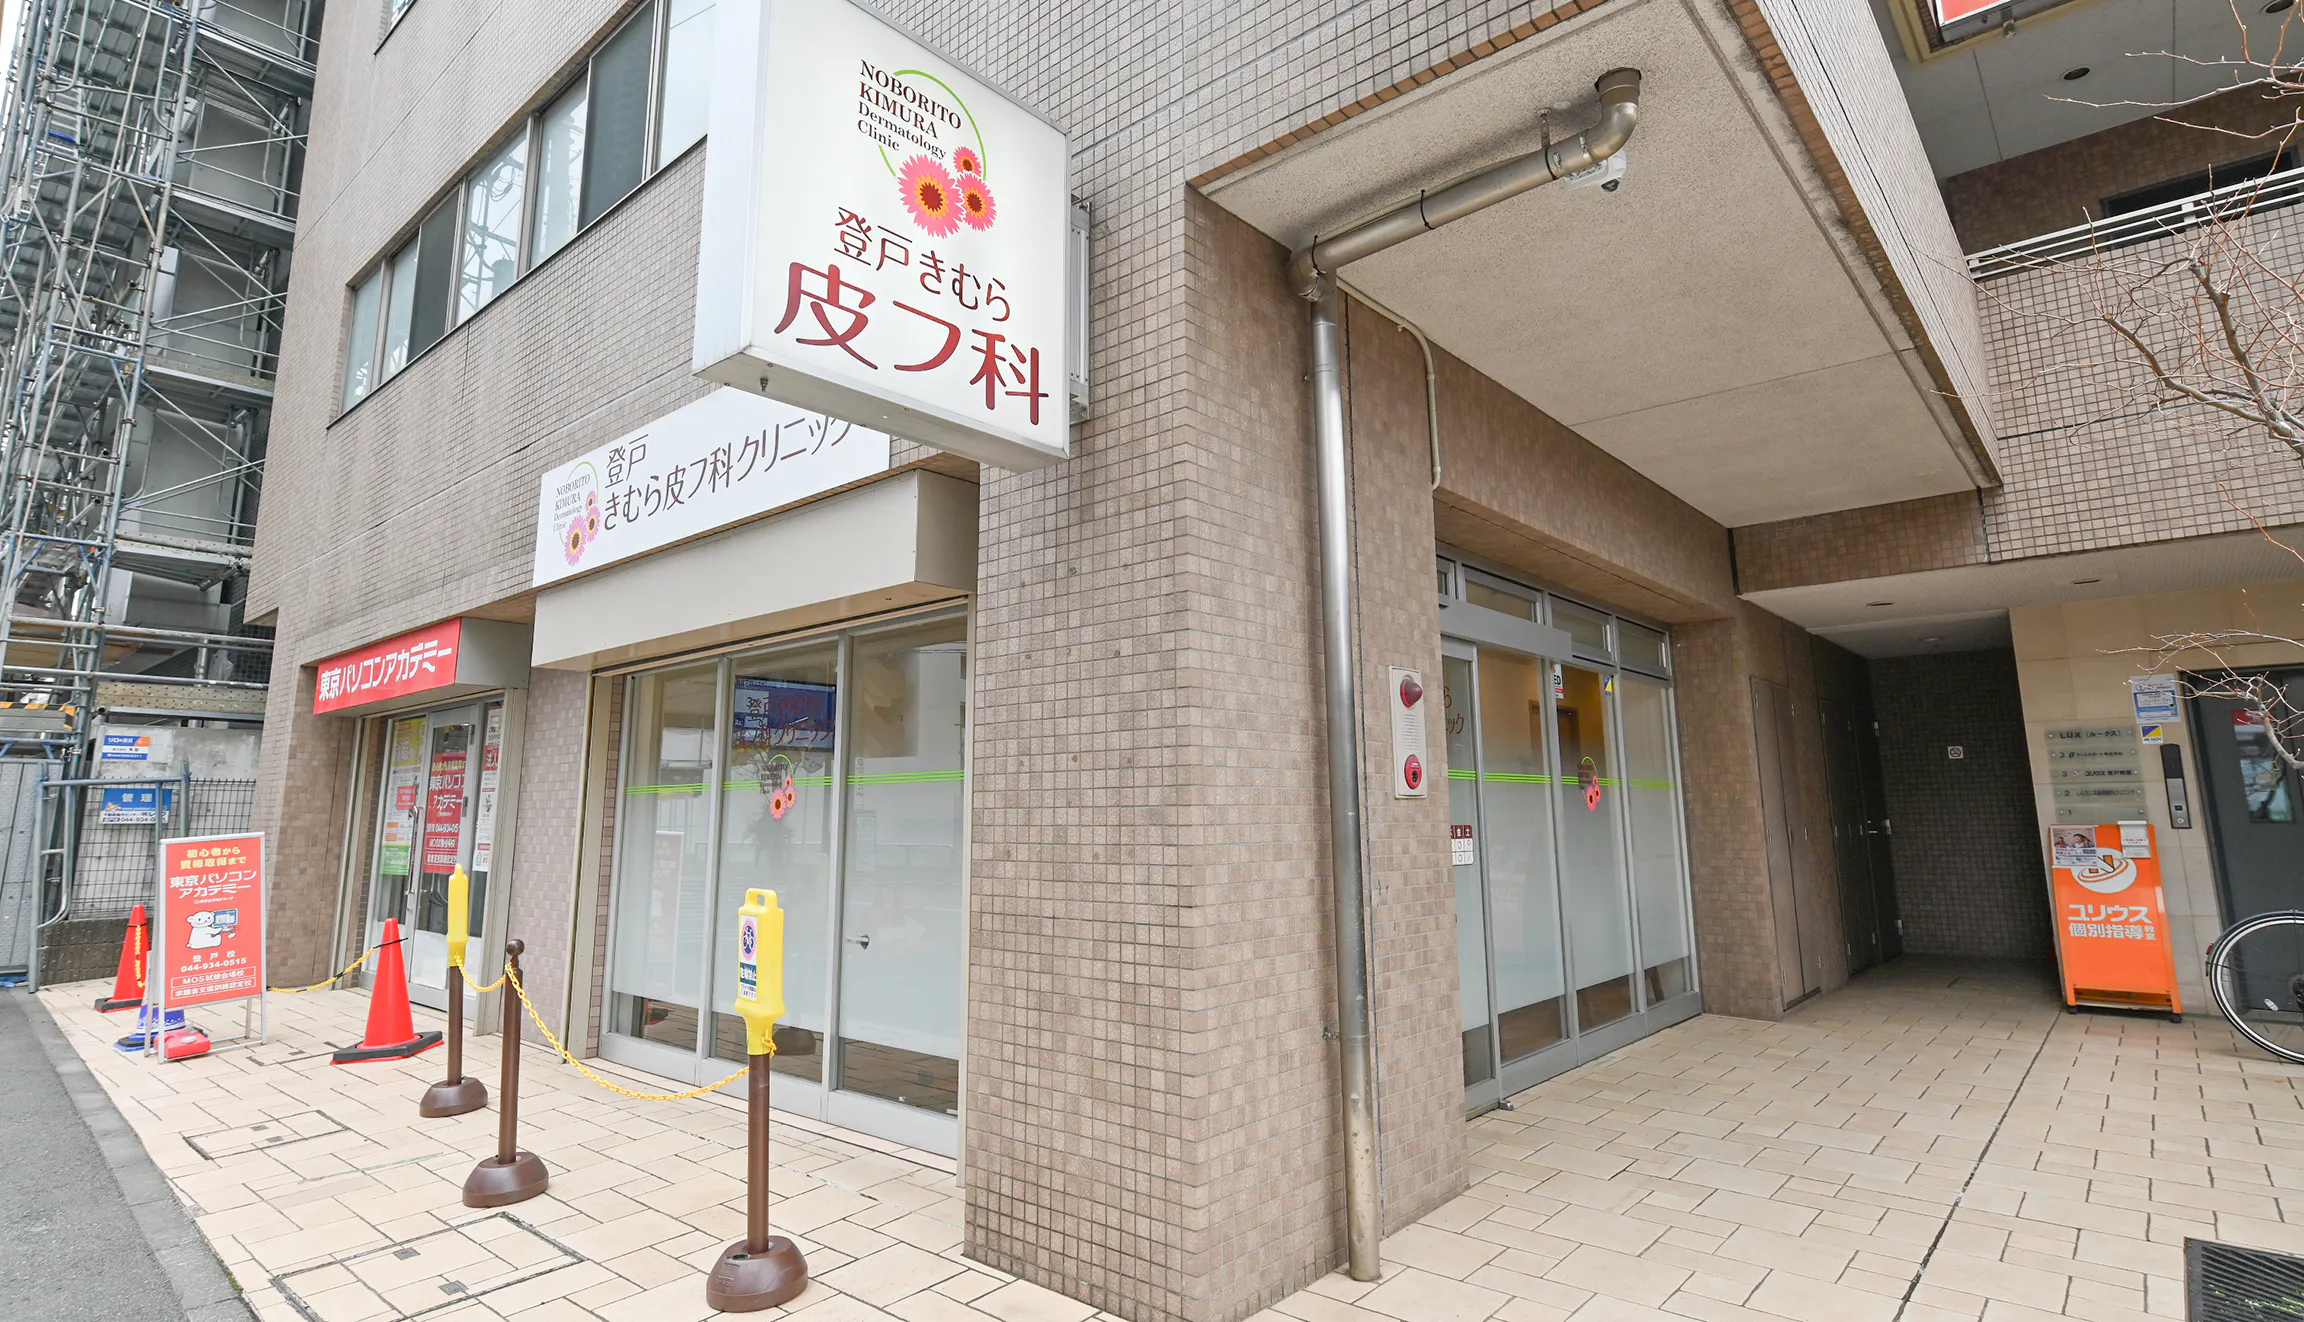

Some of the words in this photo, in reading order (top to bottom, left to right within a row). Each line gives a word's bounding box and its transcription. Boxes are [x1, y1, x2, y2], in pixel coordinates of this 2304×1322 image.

[859, 58, 962, 130] NOBORITO
[858, 81, 939, 139] KIMURA
[857, 119, 900, 152] Clinic
[858, 101, 948, 160] Dermatology
[833, 206, 1011, 322] 登戸きむら
[773, 261, 1050, 427] 皮フ科
[604, 433, 650, 490] 登戸
[556, 473, 591, 498] NOBORITO
[554, 491, 582, 512] KIMURA
[318, 639, 453, 702] 東京パソコンアカデミー
[2059, 751, 2065, 759] 3
[186, 846, 241, 859] 初心者から
[169, 869, 258, 888] 東京パソコン
[178, 883, 252, 899] アカデミー
[2067, 903, 2153, 924] ユリウス
[180, 957, 248, 973] 044-934-0515
